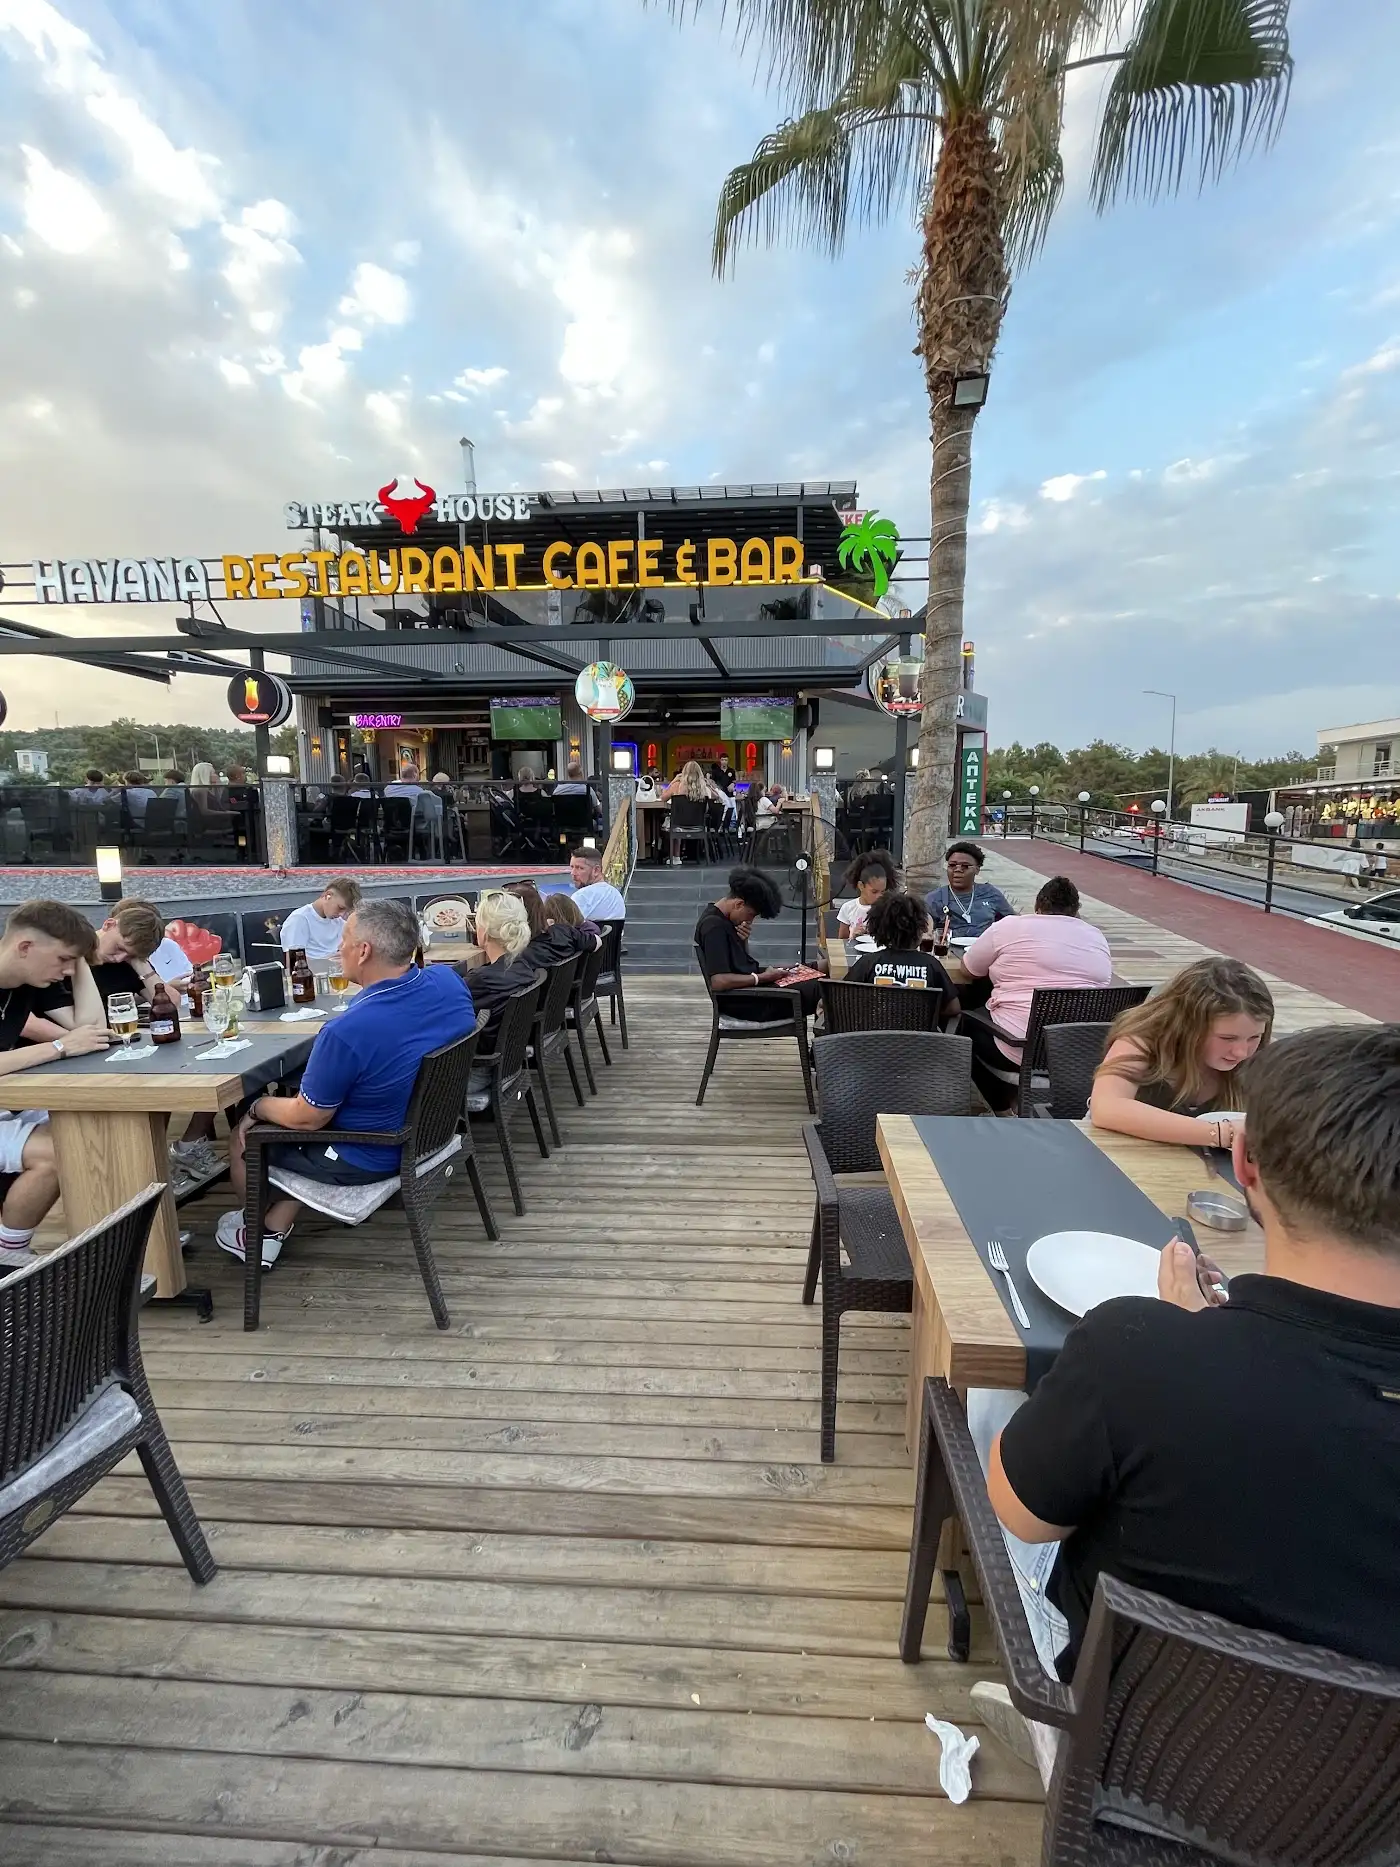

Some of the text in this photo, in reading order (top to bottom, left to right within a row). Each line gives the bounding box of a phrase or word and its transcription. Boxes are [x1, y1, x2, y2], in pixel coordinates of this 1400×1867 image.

[282, 493, 531, 529] STEAK HOUSE
[32, 535, 805, 604] HAVANA RESTAURANT CAFE & BAR
[356, 714, 402, 728] BAR ENTRY
[963, 751, 980, 831] АПТЕКА
